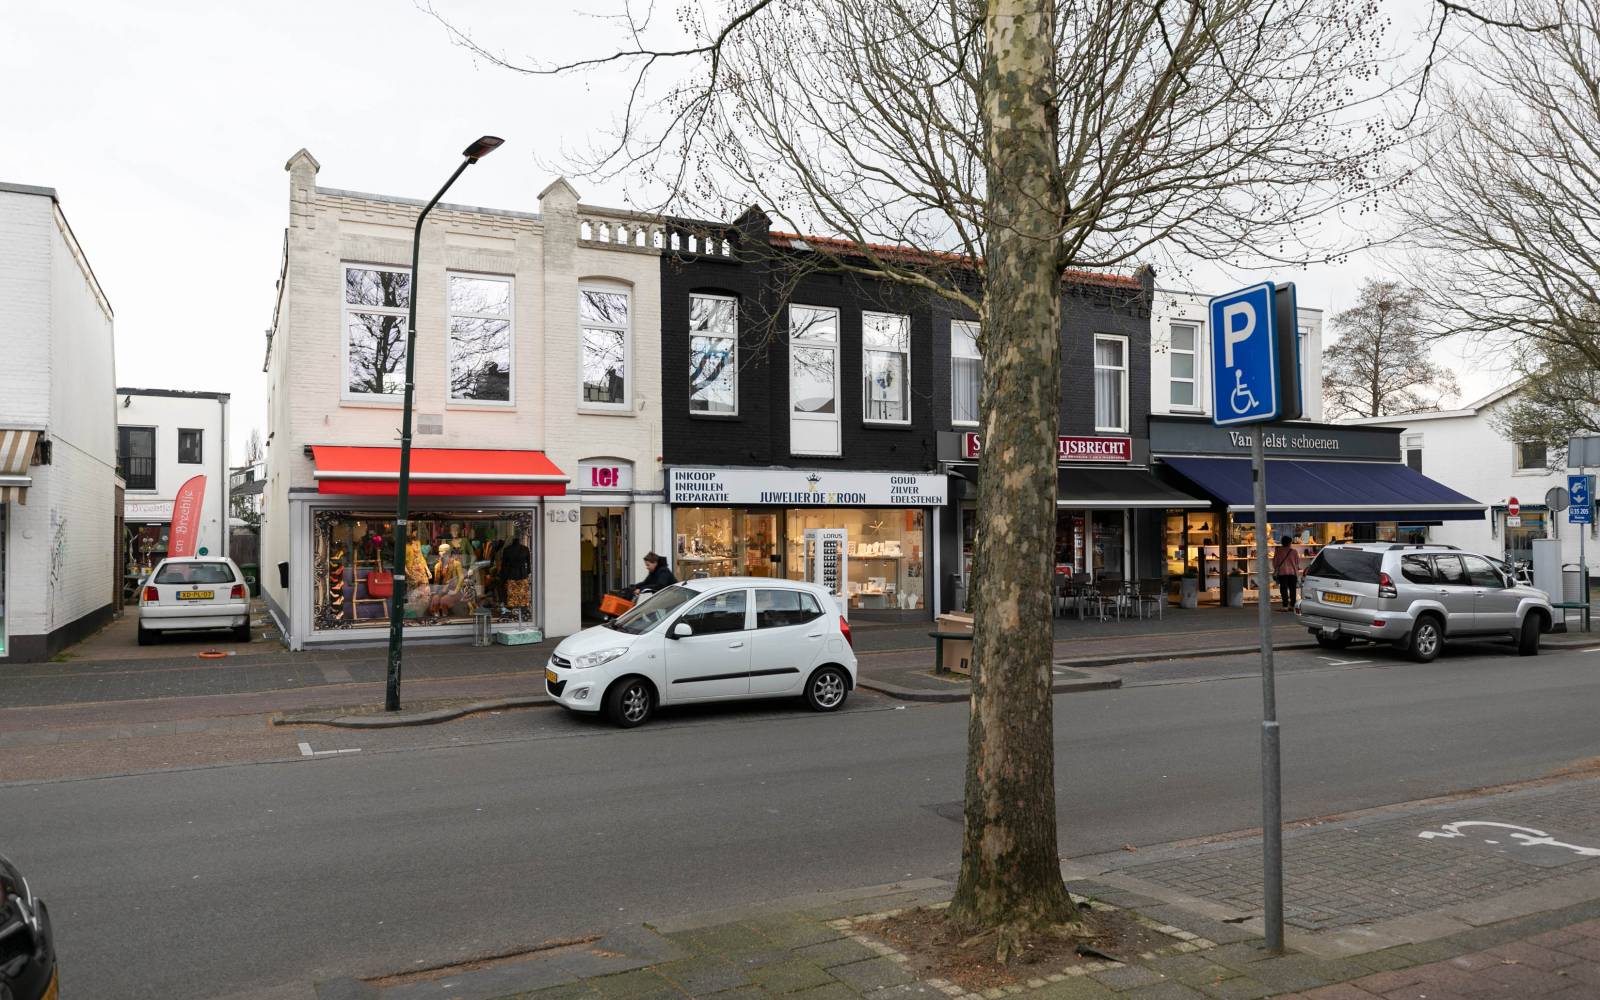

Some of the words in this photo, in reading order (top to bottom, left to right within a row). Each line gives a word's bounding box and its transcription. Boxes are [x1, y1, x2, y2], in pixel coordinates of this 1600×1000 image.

[1224, 301, 1256, 368] P
[1229, 431, 1252, 446] Van
[1291, 434, 1339, 449] schoenen
[675, 472, 715, 480] INKOOP
[890, 476, 916, 485] GOUD
[675, 482, 723, 491] INRUILEN
[890, 486, 919, 495] ZILVER
[675, 493, 729, 502] REPARATIE
[760, 491, 811, 503] JUWELIER
[812, 492, 826, 503] DE
[828, 492, 866, 504] KROON
[890, 495, 942, 504] EDELSTENEN
[547, 509, 579, 522] 126
